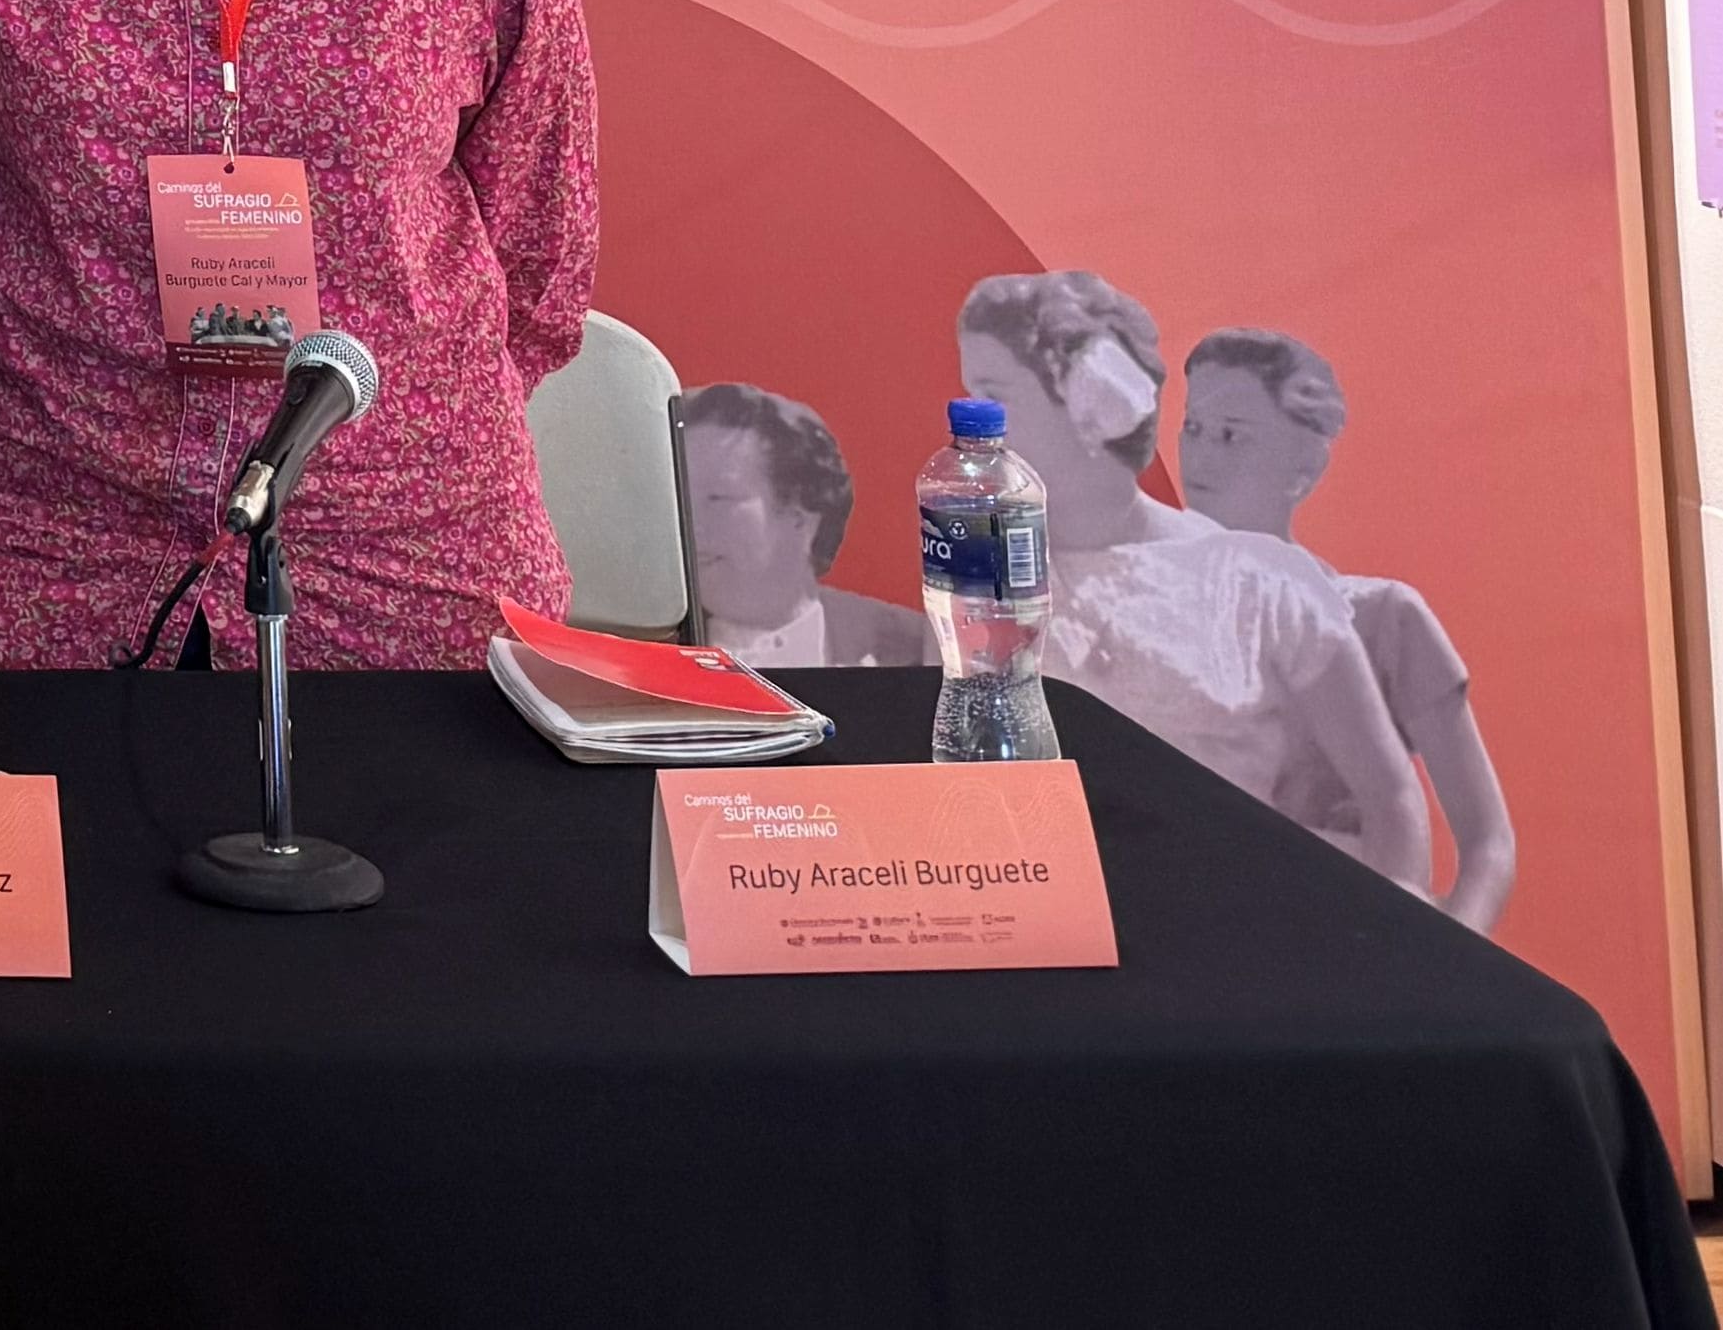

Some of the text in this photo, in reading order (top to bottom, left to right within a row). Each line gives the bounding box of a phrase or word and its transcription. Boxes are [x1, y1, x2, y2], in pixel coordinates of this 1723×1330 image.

[193, 194, 272, 208] SUFRAGIO
[221, 210, 302, 224] FEMENINO
[191, 256, 275, 272] Ruby Araceli
[166, 274, 227, 289] Burguete
[255, 277, 264, 288] y
[266, 275, 309, 288] Mayor
[735, 793, 752, 805] del
[723, 805, 804, 822] SUFRAGIO
[753, 822, 838, 838] FEMENINO
[728, 857, 1049, 895] Ruby Araceli Burguete
